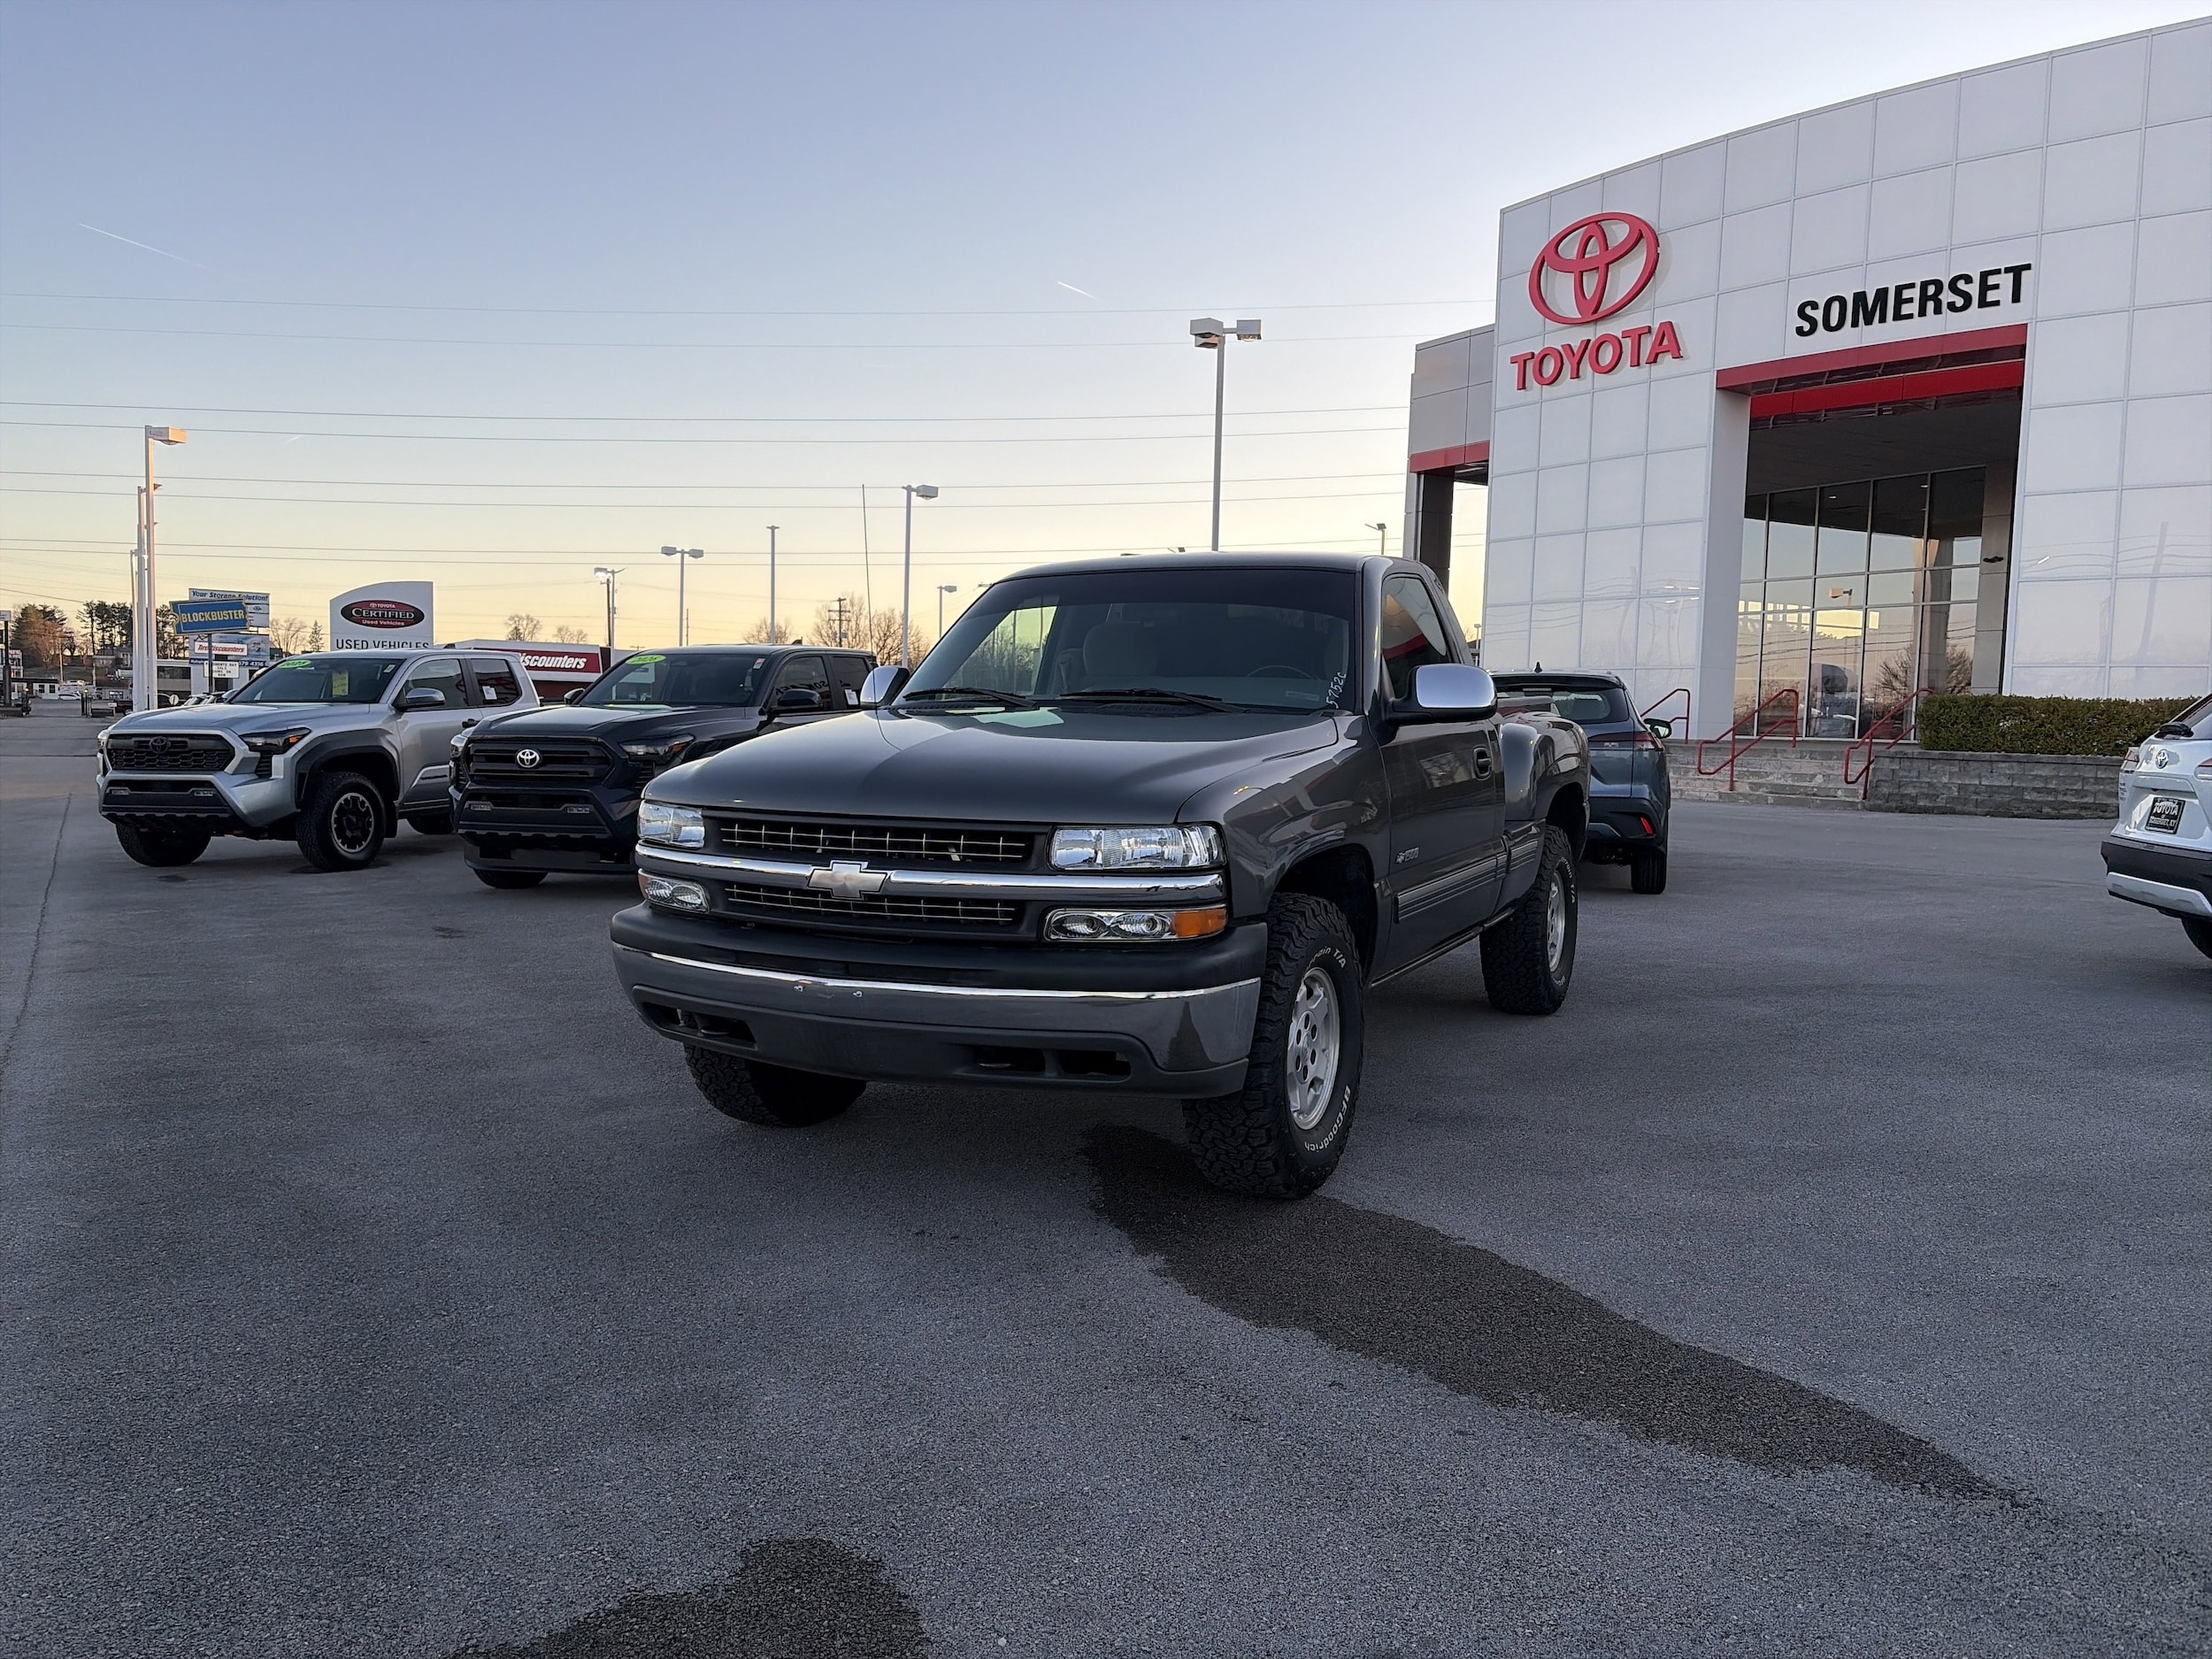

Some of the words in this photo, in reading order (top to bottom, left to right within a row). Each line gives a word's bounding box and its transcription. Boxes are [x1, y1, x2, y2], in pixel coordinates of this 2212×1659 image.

[1795, 263, 2032, 337] SOMERSET
[1510, 320, 1684, 391] TOYOTA
[181, 610, 244, 623] BLOCKBUSTER
[351, 608, 415, 619] CERTIFIED
[336, 639, 369, 650] USED
[520, 653, 588, 670] iscounters
[2153, 802, 2179, 816] TOYOTA
[1333, 948, 1347, 969] T/A
[1304, 1085, 1351, 1153] BFGoodrich
